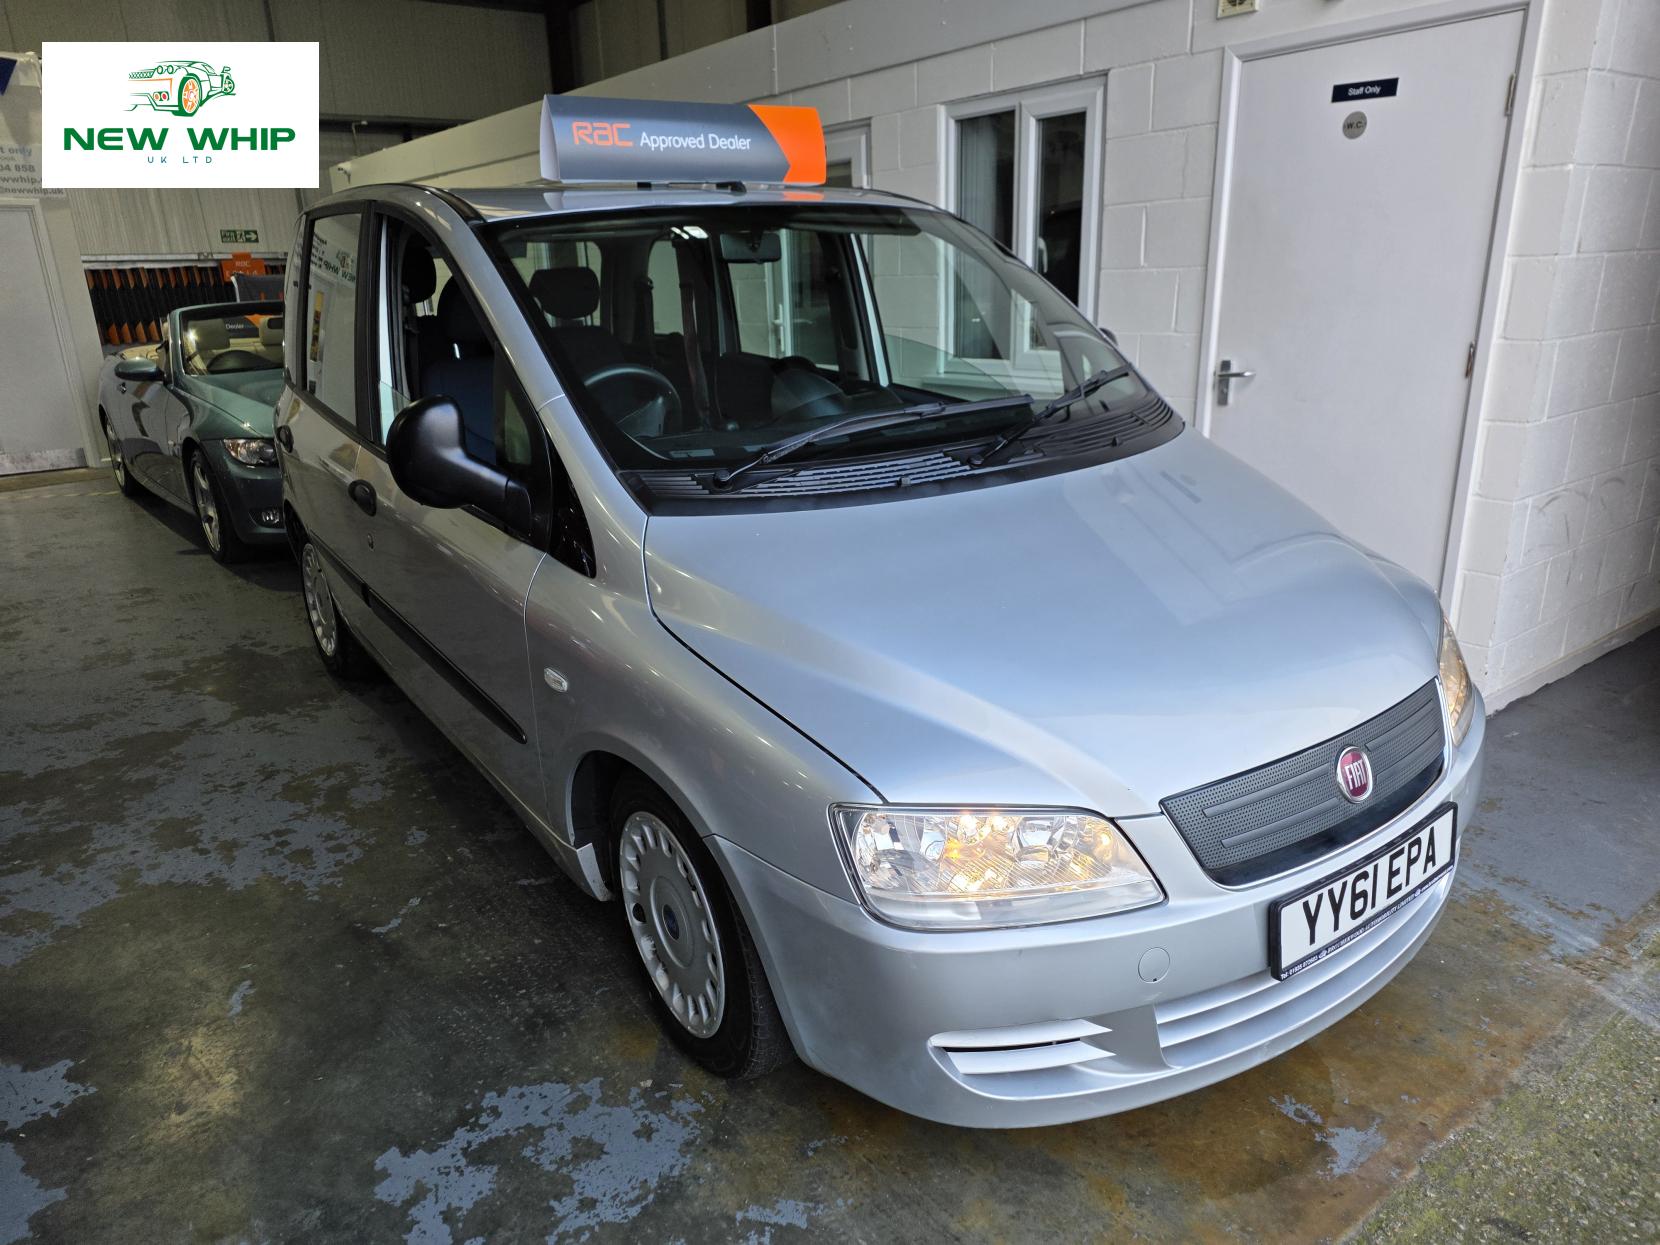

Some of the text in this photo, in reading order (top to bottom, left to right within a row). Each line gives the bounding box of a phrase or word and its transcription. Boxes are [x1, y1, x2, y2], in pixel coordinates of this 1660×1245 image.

[1348, 85, 1381, 96] Staff Only
[640, 132, 705, 151] Approved
[709, 133, 751, 150] Dealer
[1344, 759, 1367, 790] FIAT
[1302, 826, 1437, 946] YY61 EPA
